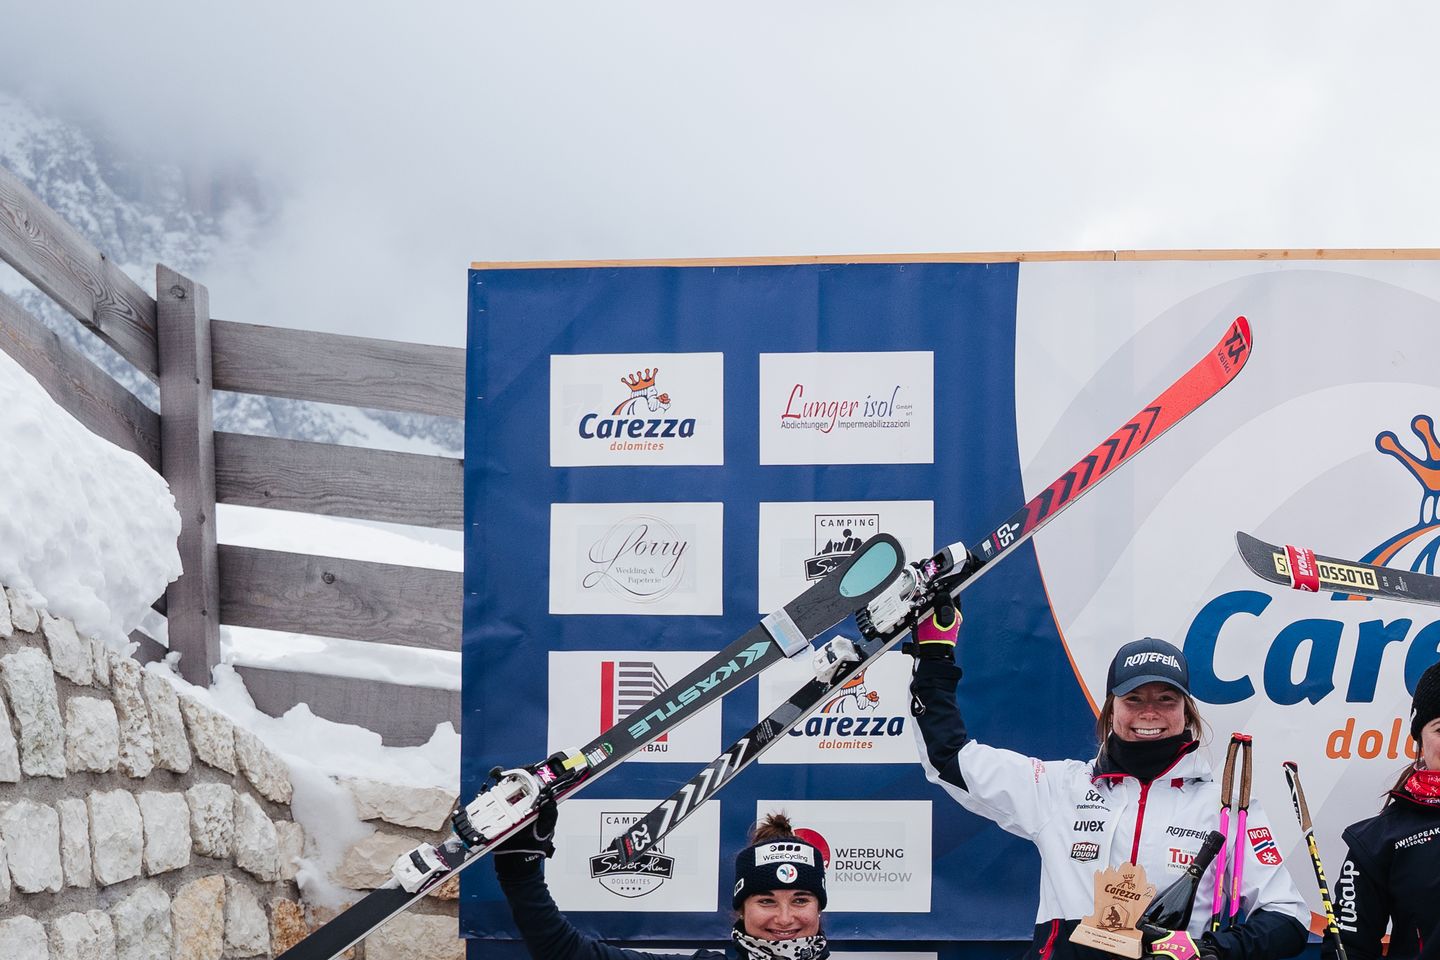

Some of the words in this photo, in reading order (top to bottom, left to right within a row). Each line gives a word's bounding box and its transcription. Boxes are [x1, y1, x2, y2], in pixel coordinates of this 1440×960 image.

[782, 384, 859, 434] Lunger
[863, 384, 901, 418] isol
[578, 413, 697, 440] Carezza
[781, 421, 829, 430] Abdichtungen
[838, 420, 911, 430] Impermeabilizzazioni
[609, 441, 664, 451] dolomites
[820, 519, 876, 528] CAMPING
[616, 566, 648, 576] Wedding
[1318, 562, 1376, 586] BLOSSO
[818, 739, 873, 750] dolomites
[1073, 820, 1105, 832] uvex
[1249, 829, 1270, 840] NOR
[1394, 827, 1440, 850] SWISSPEAK
[835, 848, 904, 859] WERBUNG
[1071, 851, 1097, 859] TOUGH
[642, 859, 670, 873] Alm
[835, 860, 881, 871] DRUCK
[835, 873, 912, 883] KNOWHOW
[1104, 884, 1142, 901] Carezza
[1336, 860, 1360, 933] fusalp
